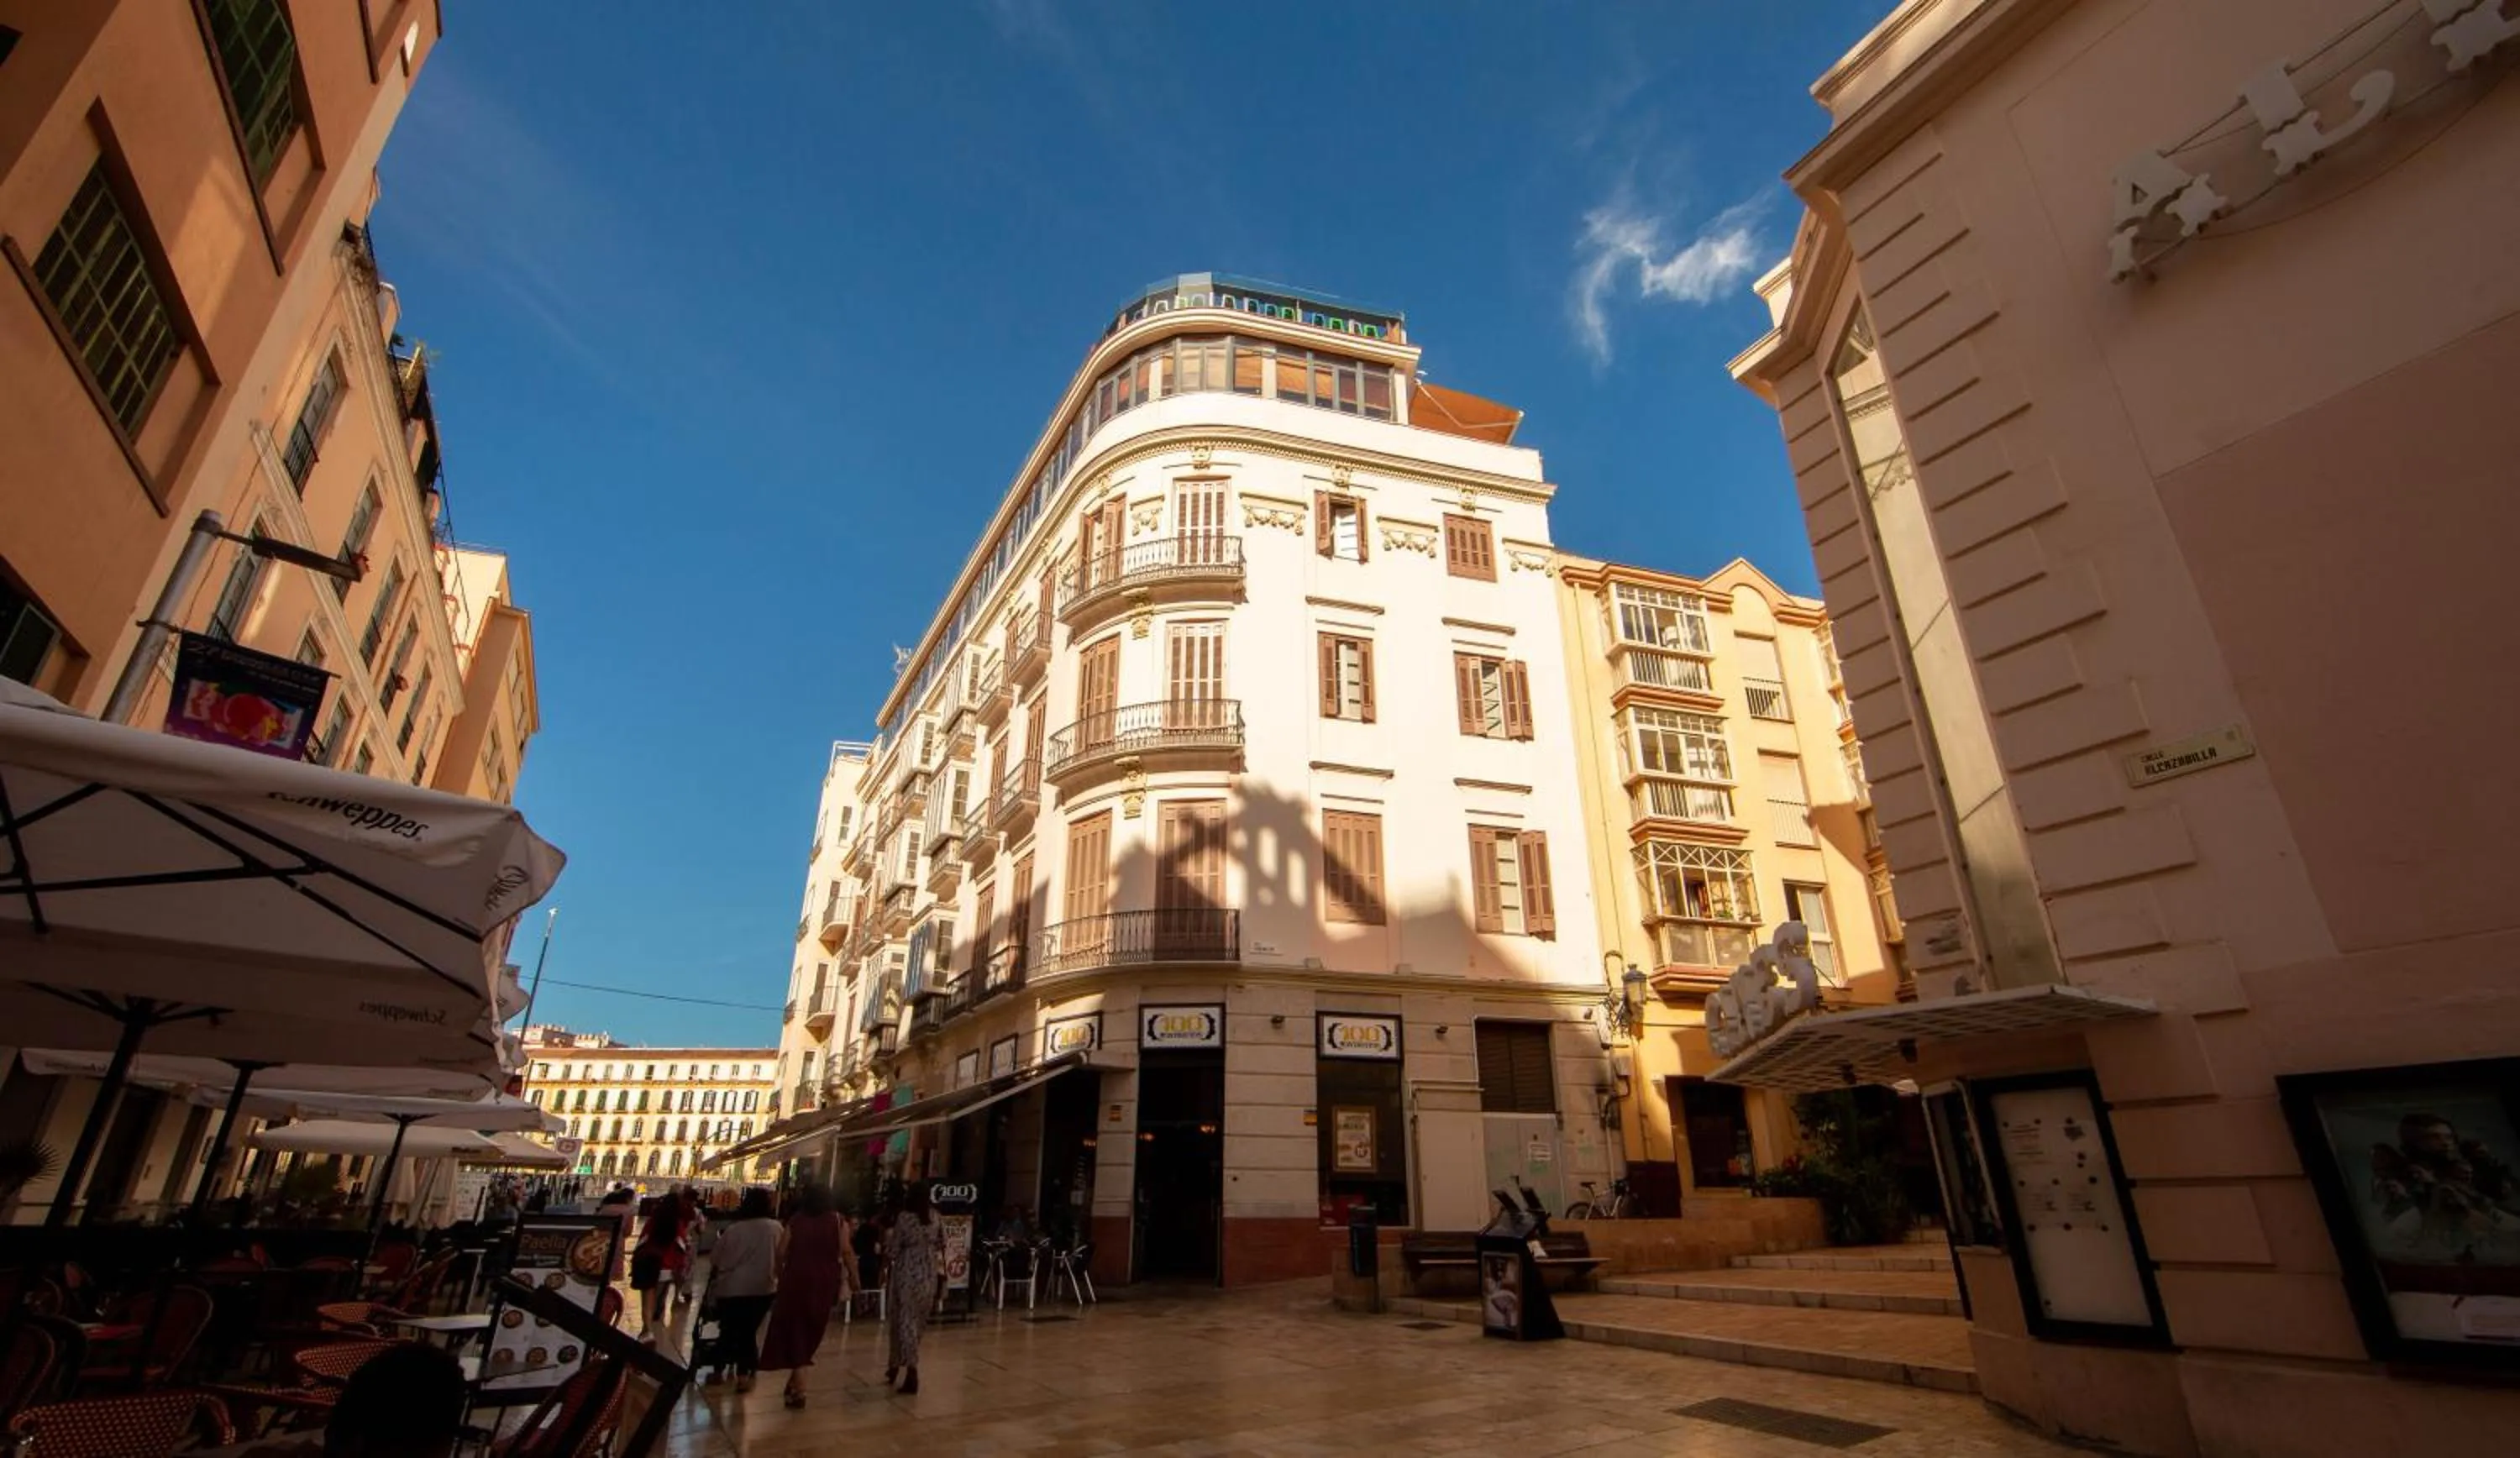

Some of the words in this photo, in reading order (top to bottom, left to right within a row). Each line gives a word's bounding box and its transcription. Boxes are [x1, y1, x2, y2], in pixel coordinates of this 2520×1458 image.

[1160, 1015, 1203, 1032] 100
[1339, 1025, 1379, 1041] 100
[938, 1184, 969, 1197] 100
[520, 1233, 567, 1250] Paella
